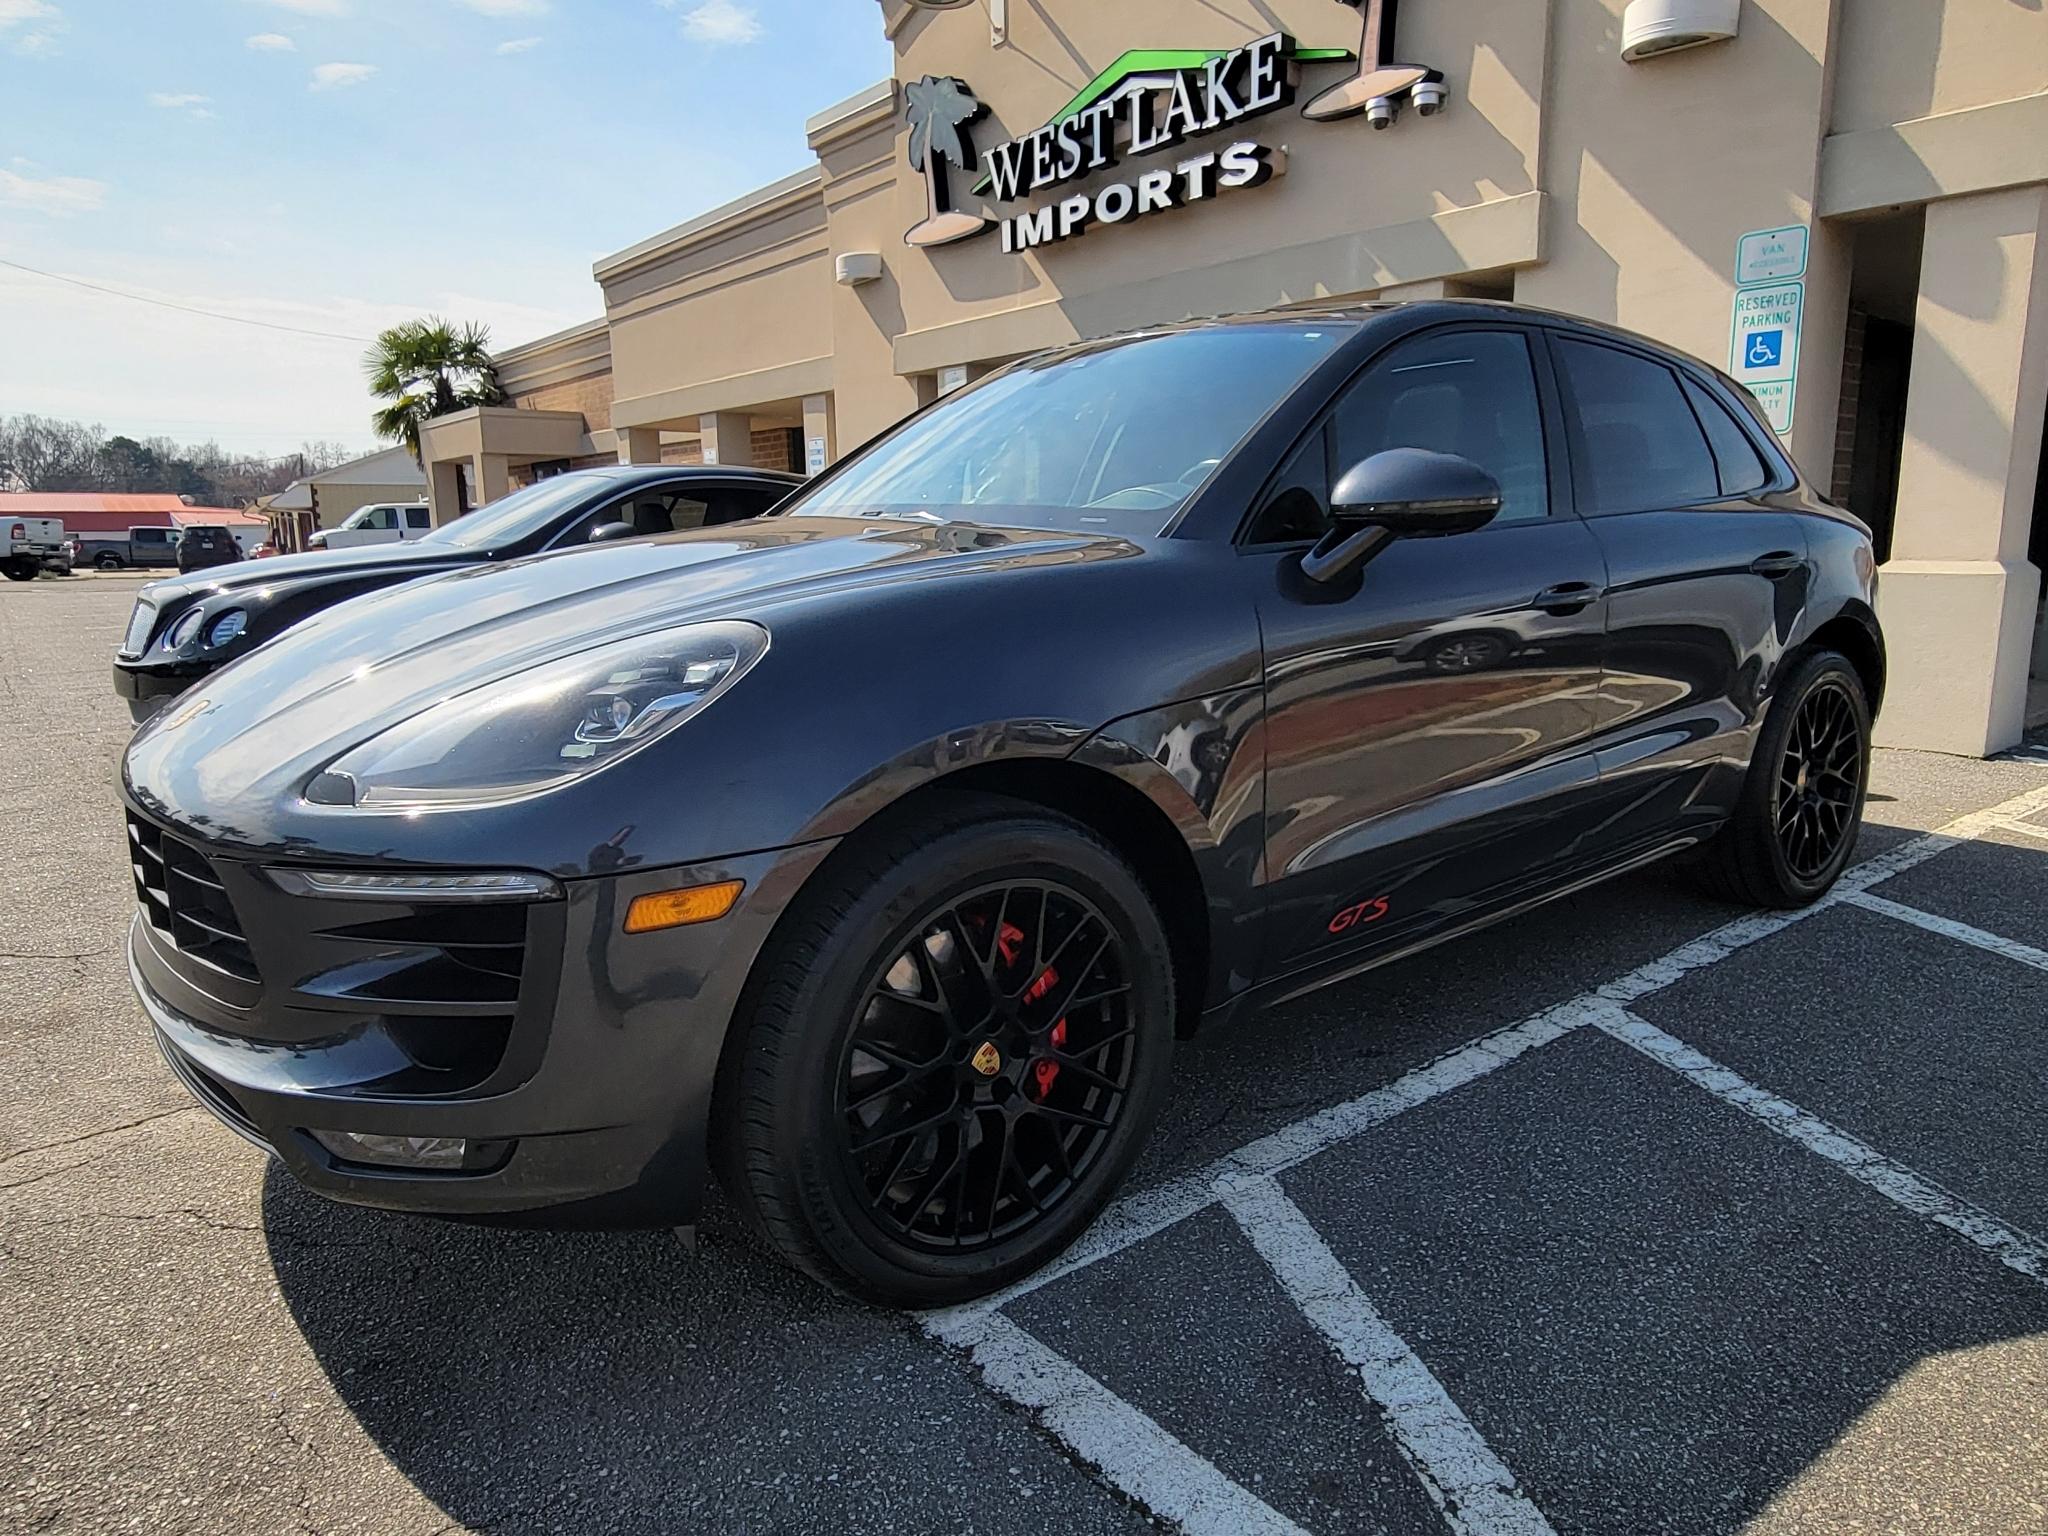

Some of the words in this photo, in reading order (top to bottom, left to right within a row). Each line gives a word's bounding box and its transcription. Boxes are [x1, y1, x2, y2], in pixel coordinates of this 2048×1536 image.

[981, 100, 1114, 202] WEST
[1127, 31, 1283, 155] LAKE
[1001, 141, 1259, 254] IMPORTS
[1761, 243, 1785, 257] VAN
[1737, 291, 1798, 312] RESERVED
[1742, 310, 1791, 329] PARKING
[1752, 384, 1783, 396] XIMUM
[1328, 895, 1390, 933] GTS
